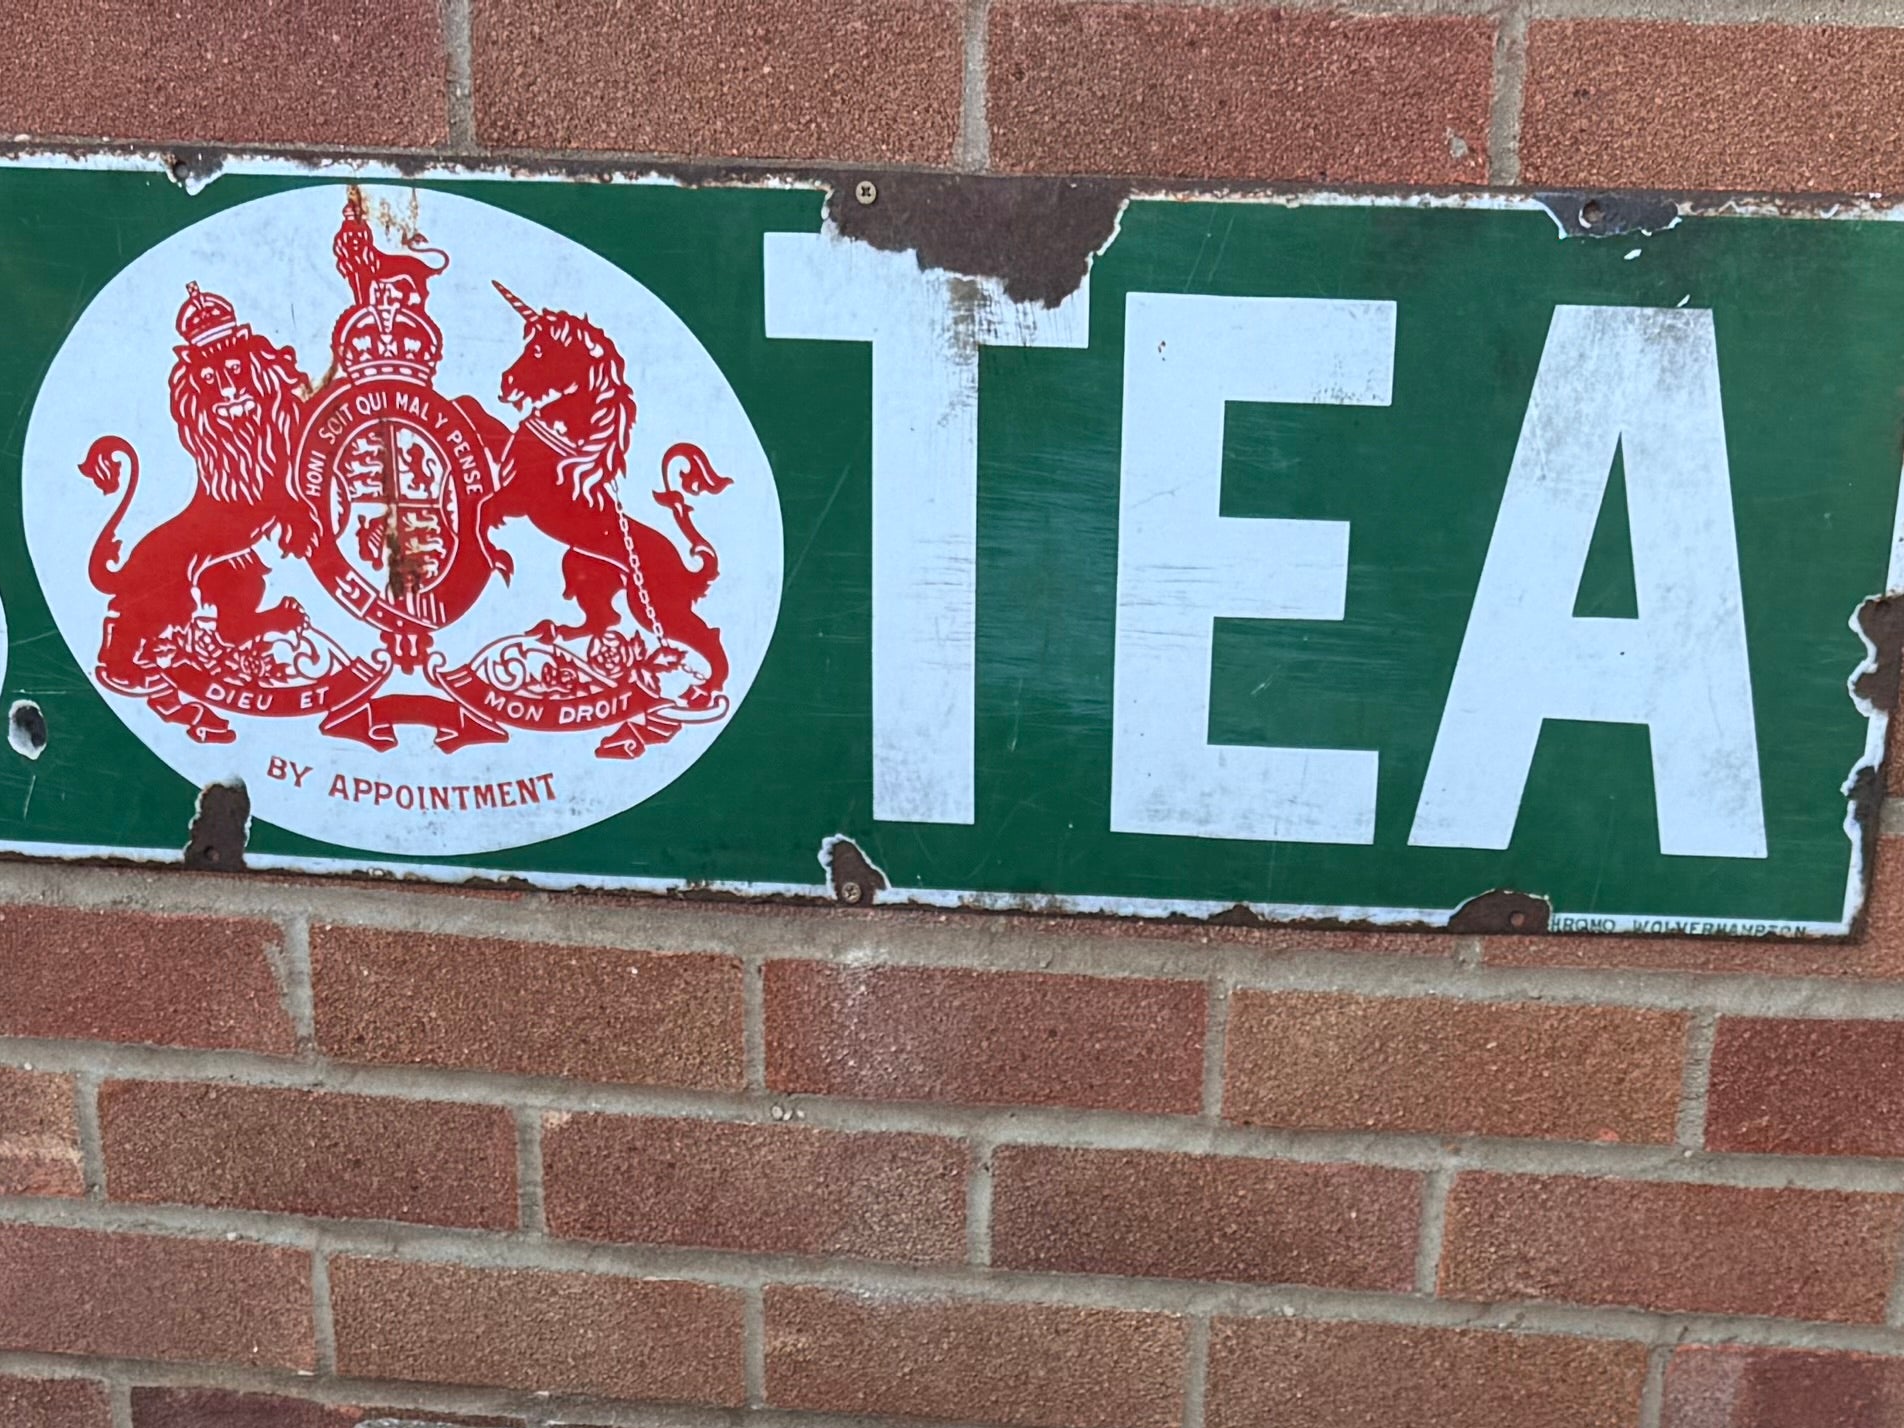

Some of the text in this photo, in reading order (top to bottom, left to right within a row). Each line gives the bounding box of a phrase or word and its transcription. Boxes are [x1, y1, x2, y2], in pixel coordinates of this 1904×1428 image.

[306, 391, 484, 497] HONI SOIT QUI MAL Y PENSE
[763, 231, 1767, 858] TEA
[205, 682, 330, 712] DIEU ET
[484, 690, 633, 725] MON DROIT
[266, 755, 557, 811] BY APPOINTMENT
